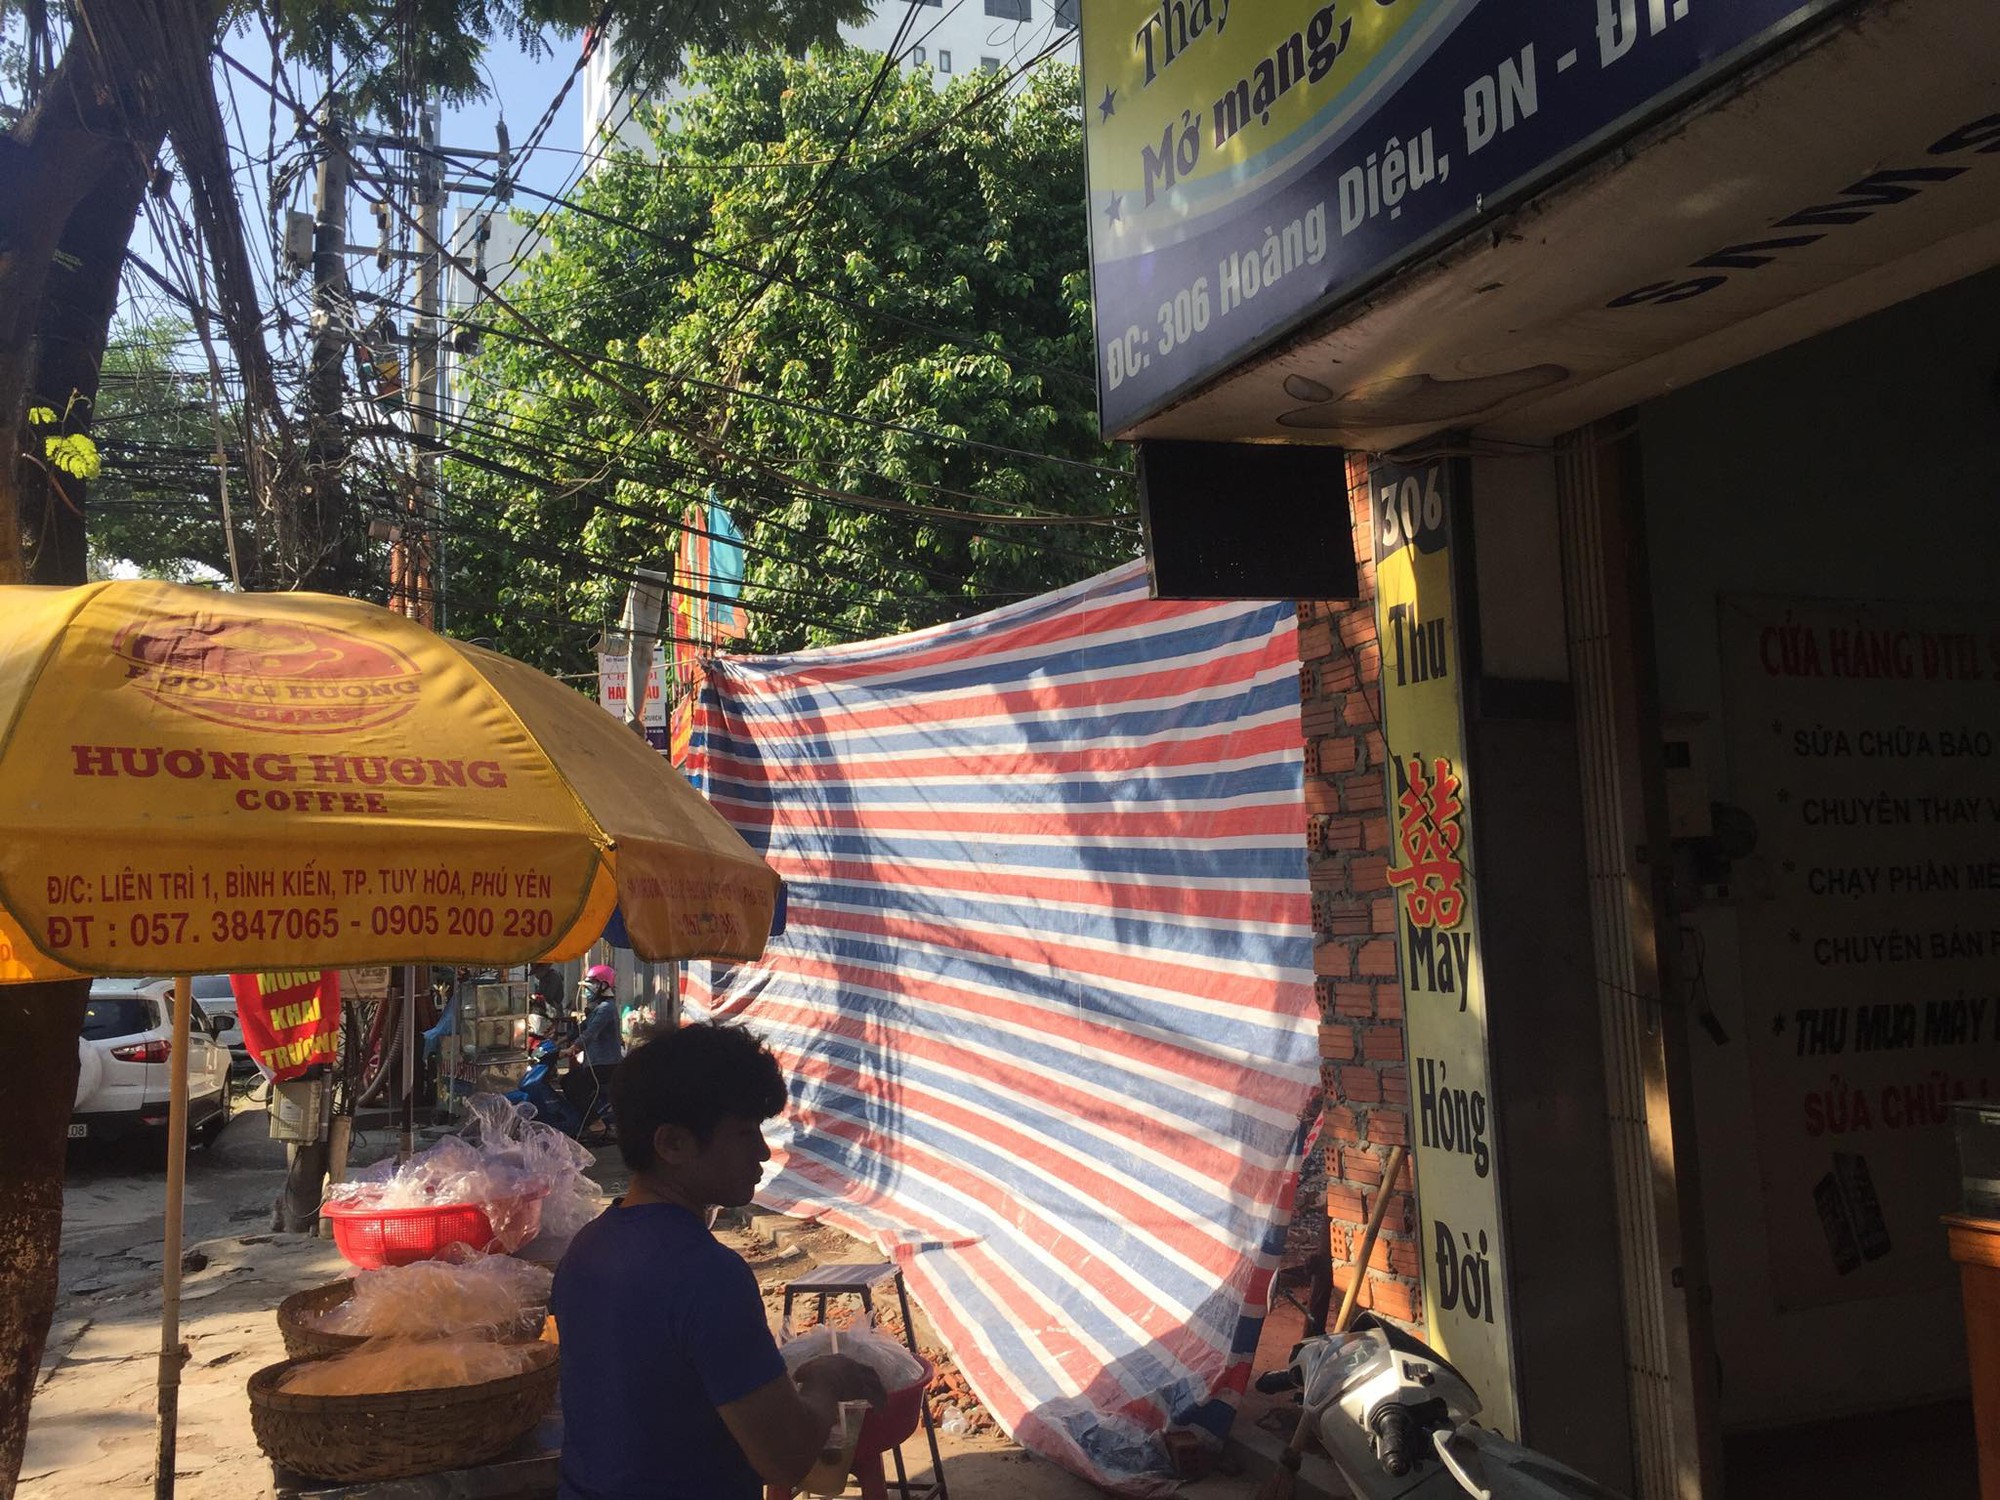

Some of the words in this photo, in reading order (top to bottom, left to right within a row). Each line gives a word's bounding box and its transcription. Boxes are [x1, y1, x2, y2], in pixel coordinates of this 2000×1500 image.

[1141, 109, 1201, 208] Mở
[1212, 3, 1352, 149] mạng,
[1106, 324, 1150, 391] ĐC:
[1157, 277, 1210, 355] 306
[1219, 201, 1327, 317] Hoàng
[1338, 126, 1449, 237] Diệu,
[1463, 42, 1538, 155] ĐN
[1381, 465, 1442, 546] 306
[1389, 602, 1447, 686] Thu
[71, 745, 297, 782] HƯƠNG
[1793, 724, 1851, 757] SỬA
[236, 788, 388, 814] COFFEE
[47, 874, 92, 904] Đ/C:
[101, 866, 152, 902] LIÊN
[159, 864, 195, 900] TRÌ
[201, 872, 219, 904] 1,
[226, 864, 275, 898] BÌNH
[283, 858, 336, 901] KIẾN,
[342, 869, 373, 896] TP.
[378, 868, 418, 895] TUY
[423, 864, 465, 901] HÒA,
[470, 867, 508, 898] PHÚ
[514, 868, 552, 898] YÊN
[47, 915, 94, 949] ĐT
[130, 912, 200, 946] 057.
[212, 908, 340, 942] 3847065
[371, 905, 440, 936] 0905
[447, 906, 494, 937] 200
[503, 908, 553, 938] 230
[270, 997, 322, 1031] KHAI
[1416, 1057, 1489, 1178] Hỏng
[1434, 1219, 1495, 1325] Đời
